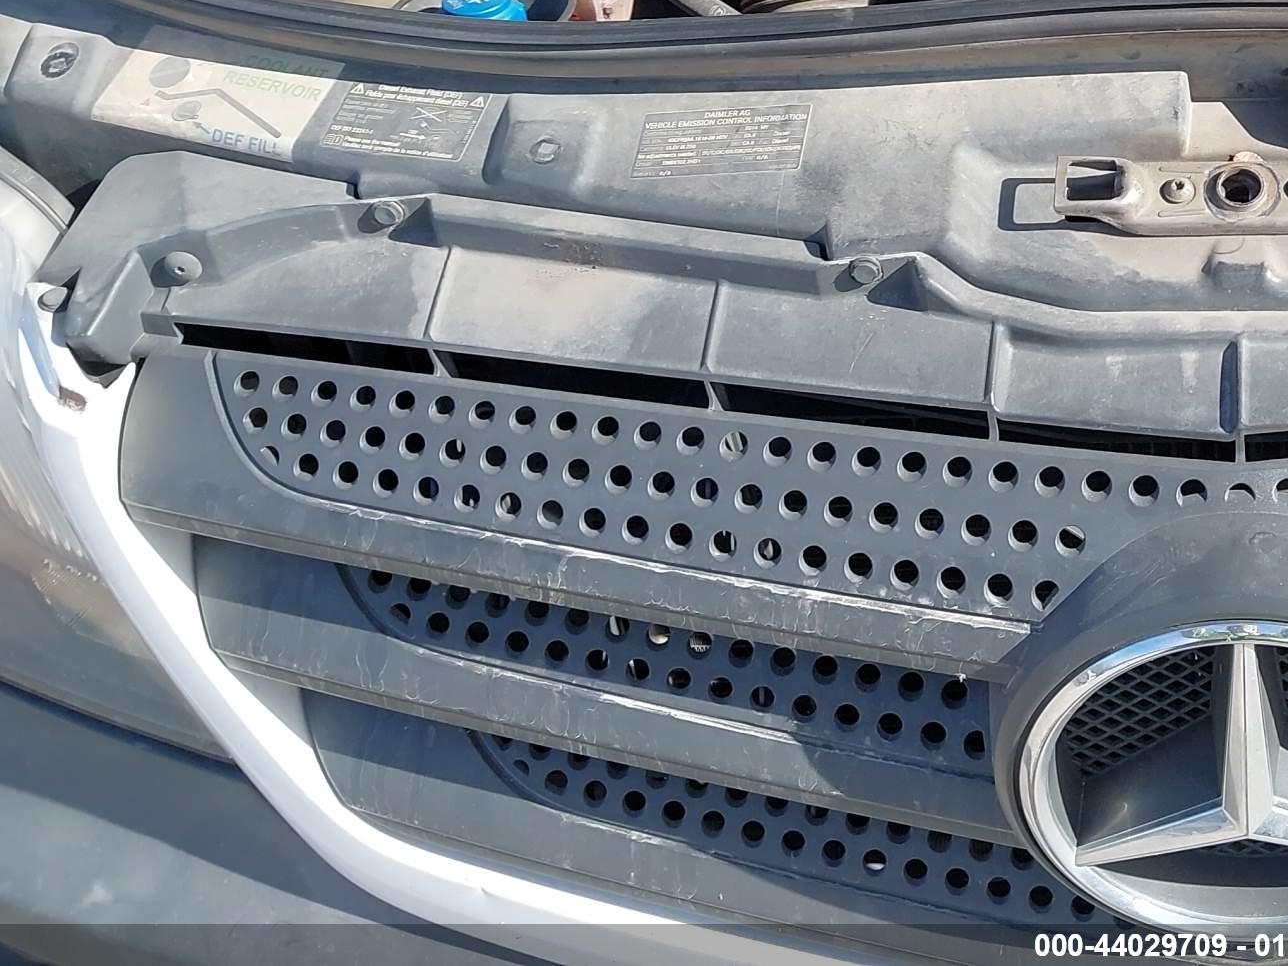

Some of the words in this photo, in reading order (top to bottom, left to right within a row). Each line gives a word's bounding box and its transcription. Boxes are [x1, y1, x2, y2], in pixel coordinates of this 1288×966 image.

[223, 70, 322, 101] RESERVOIR
[645, 121, 677, 129] VEHICLE
[677, 118, 716, 128] EMISSION
[716, 117, 753, 125] CONTROL
[754, 113, 808, 123] INFORMATION
[704, 110, 738, 119] DAIMLER
[739, 109, 751, 117] AG
[212, 128, 244, 147] DEF
[247, 137, 281, 154] FILL
